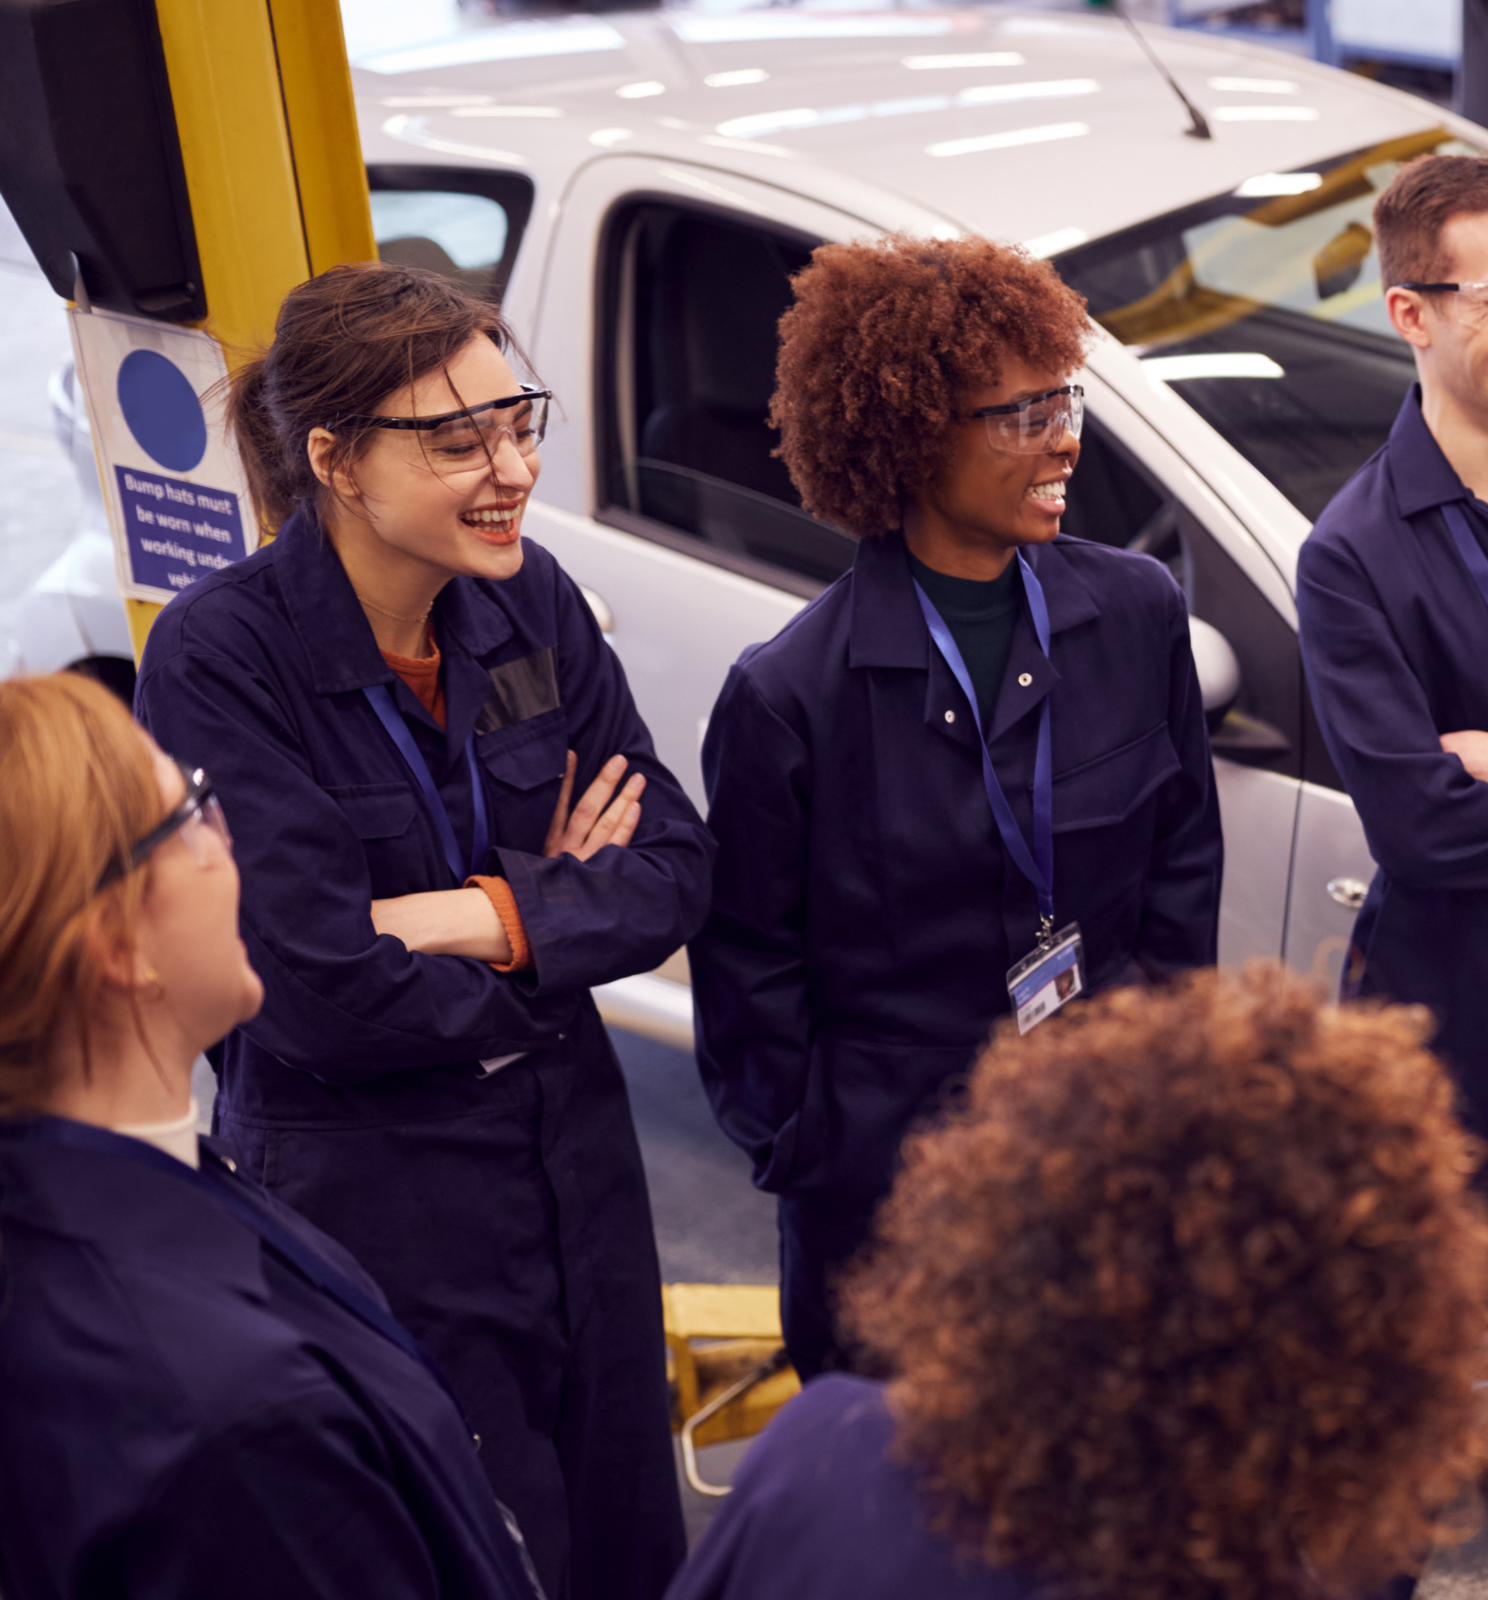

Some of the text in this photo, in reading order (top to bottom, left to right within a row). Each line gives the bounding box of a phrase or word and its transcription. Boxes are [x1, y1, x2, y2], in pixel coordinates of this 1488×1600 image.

[124, 473, 233, 515] Bump hats must
[136, 503, 232, 544] be worn when
[141, 537, 197, 567] working
